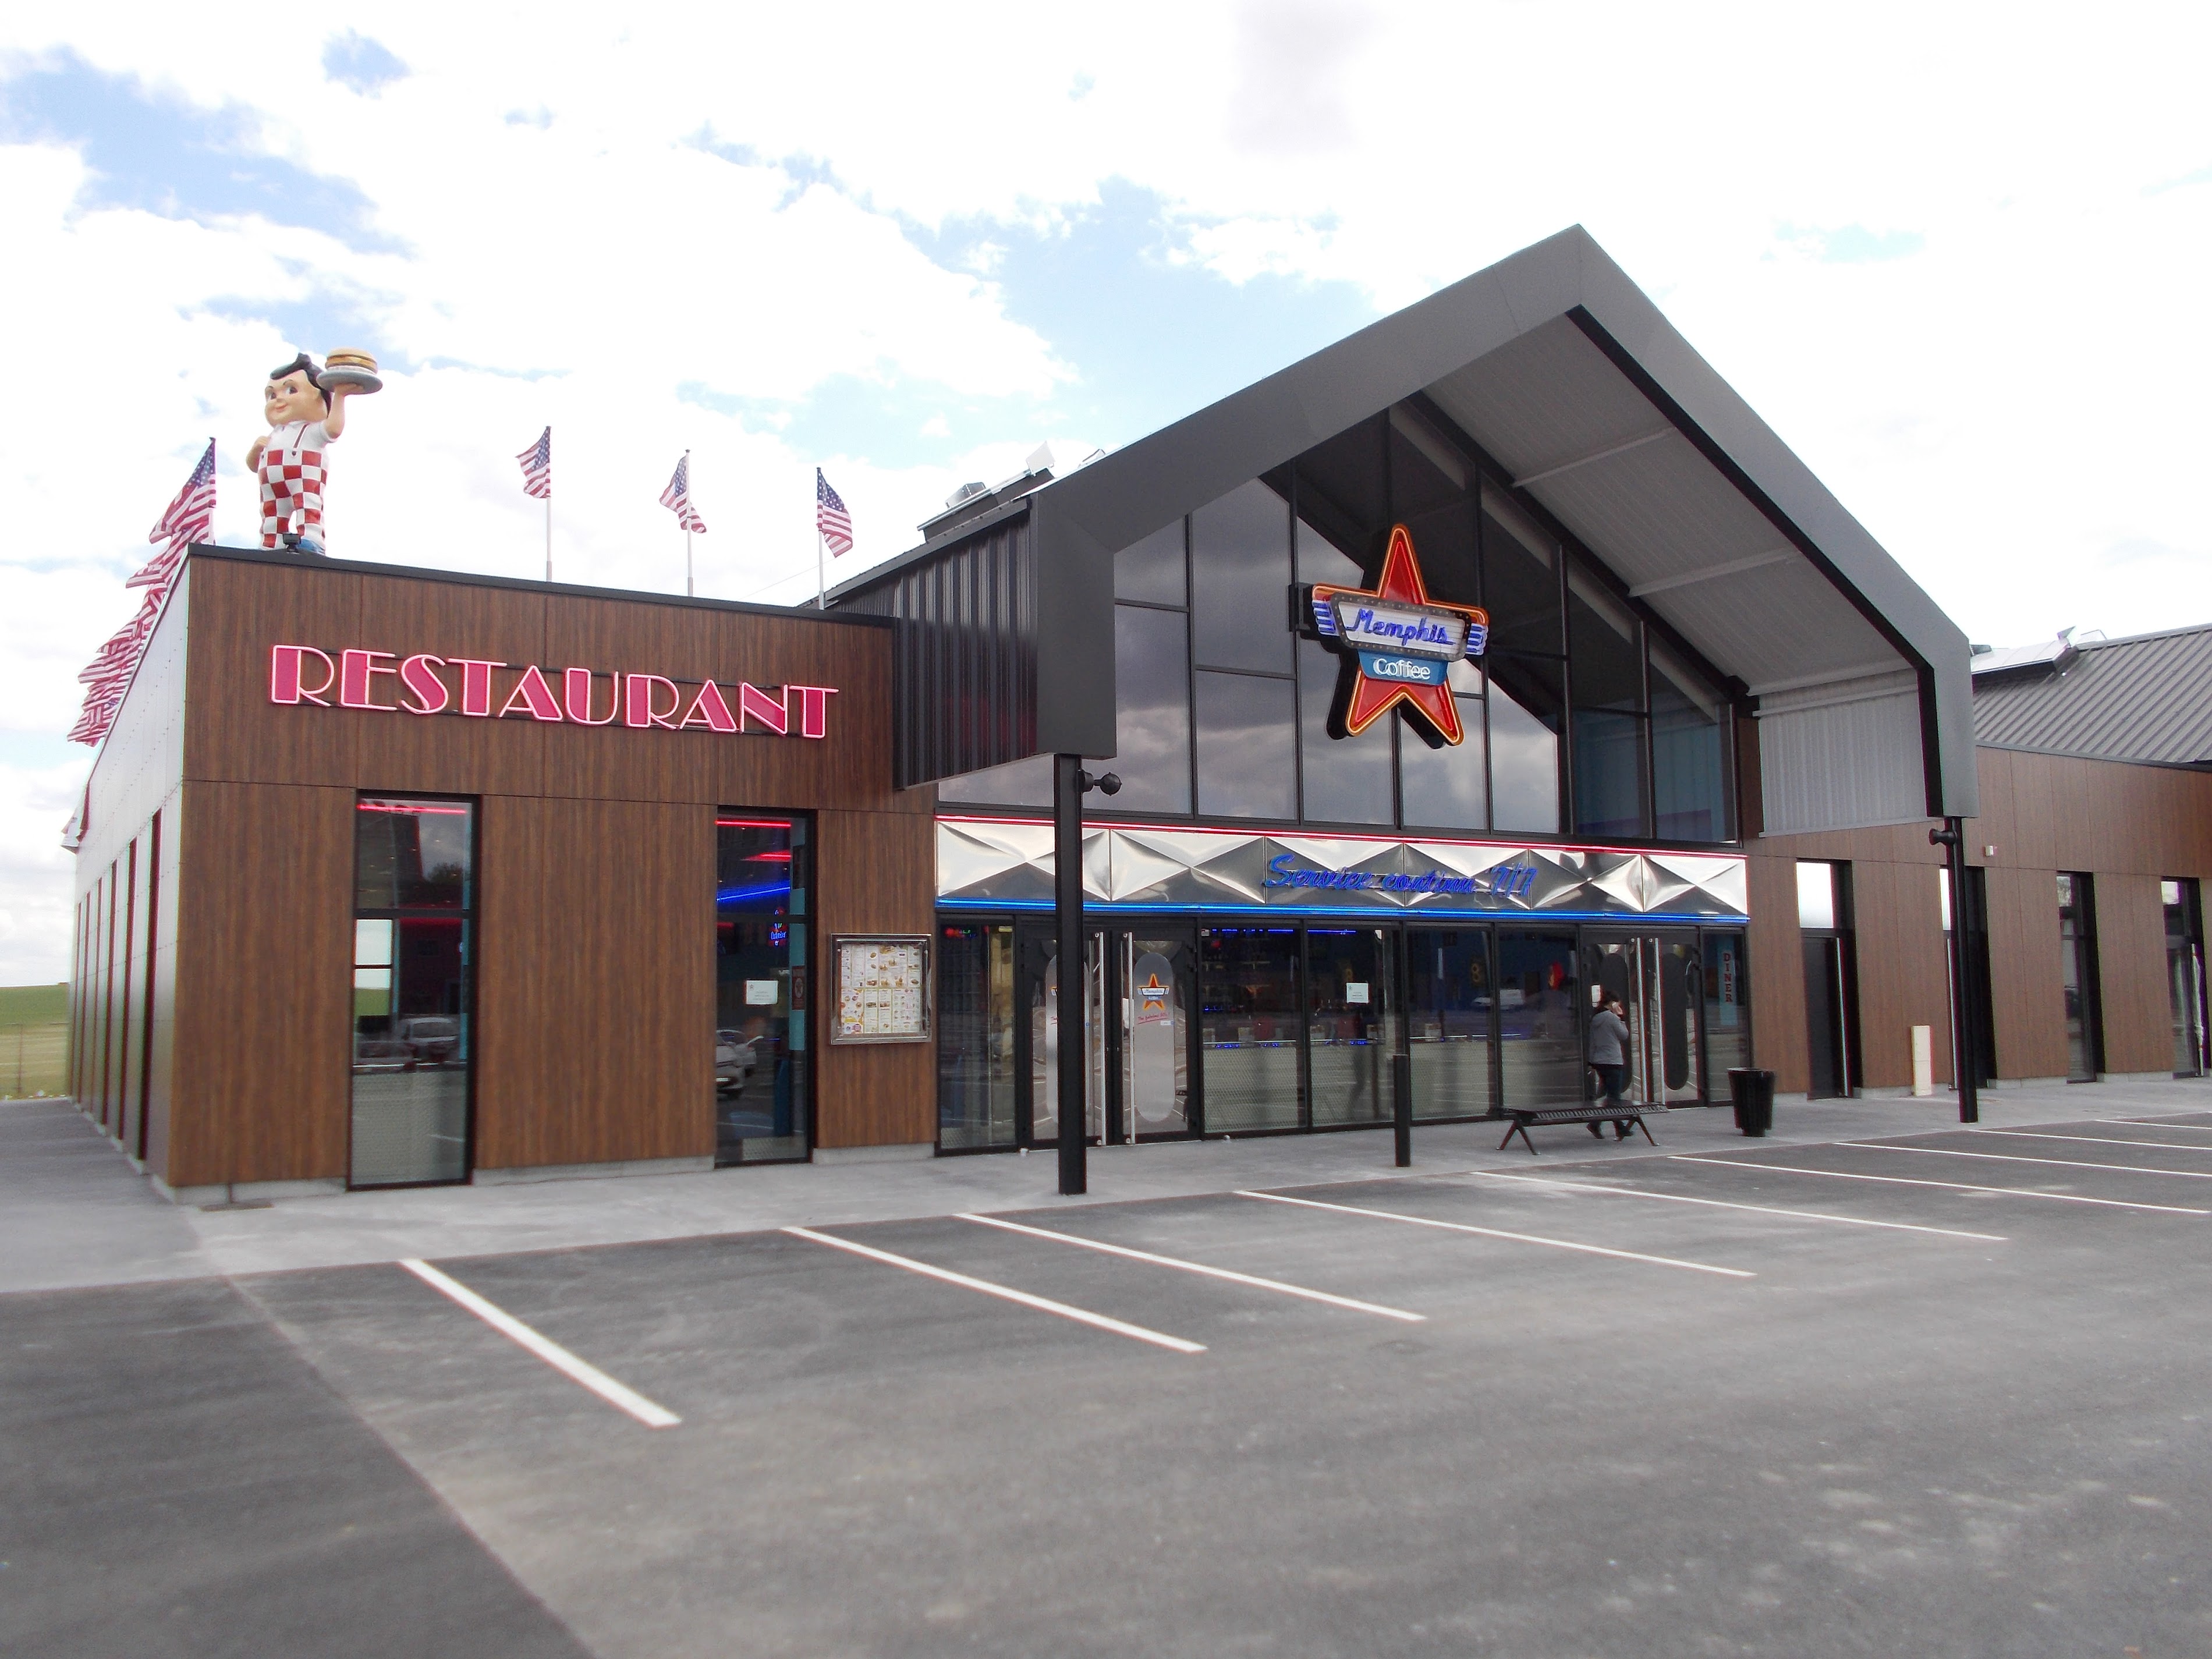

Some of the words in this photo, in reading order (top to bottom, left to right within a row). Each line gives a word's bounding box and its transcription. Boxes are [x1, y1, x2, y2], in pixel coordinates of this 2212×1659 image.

[1345, 608, 1455, 646] Memphis
[1373, 658, 1431, 680] Coffee
[271, 644, 839, 739] RESTAURANT
[1264, 853, 1373, 891] Service
[1382, 869, 1476, 894] continu
[1723, 953, 1732, 1002] DINER
